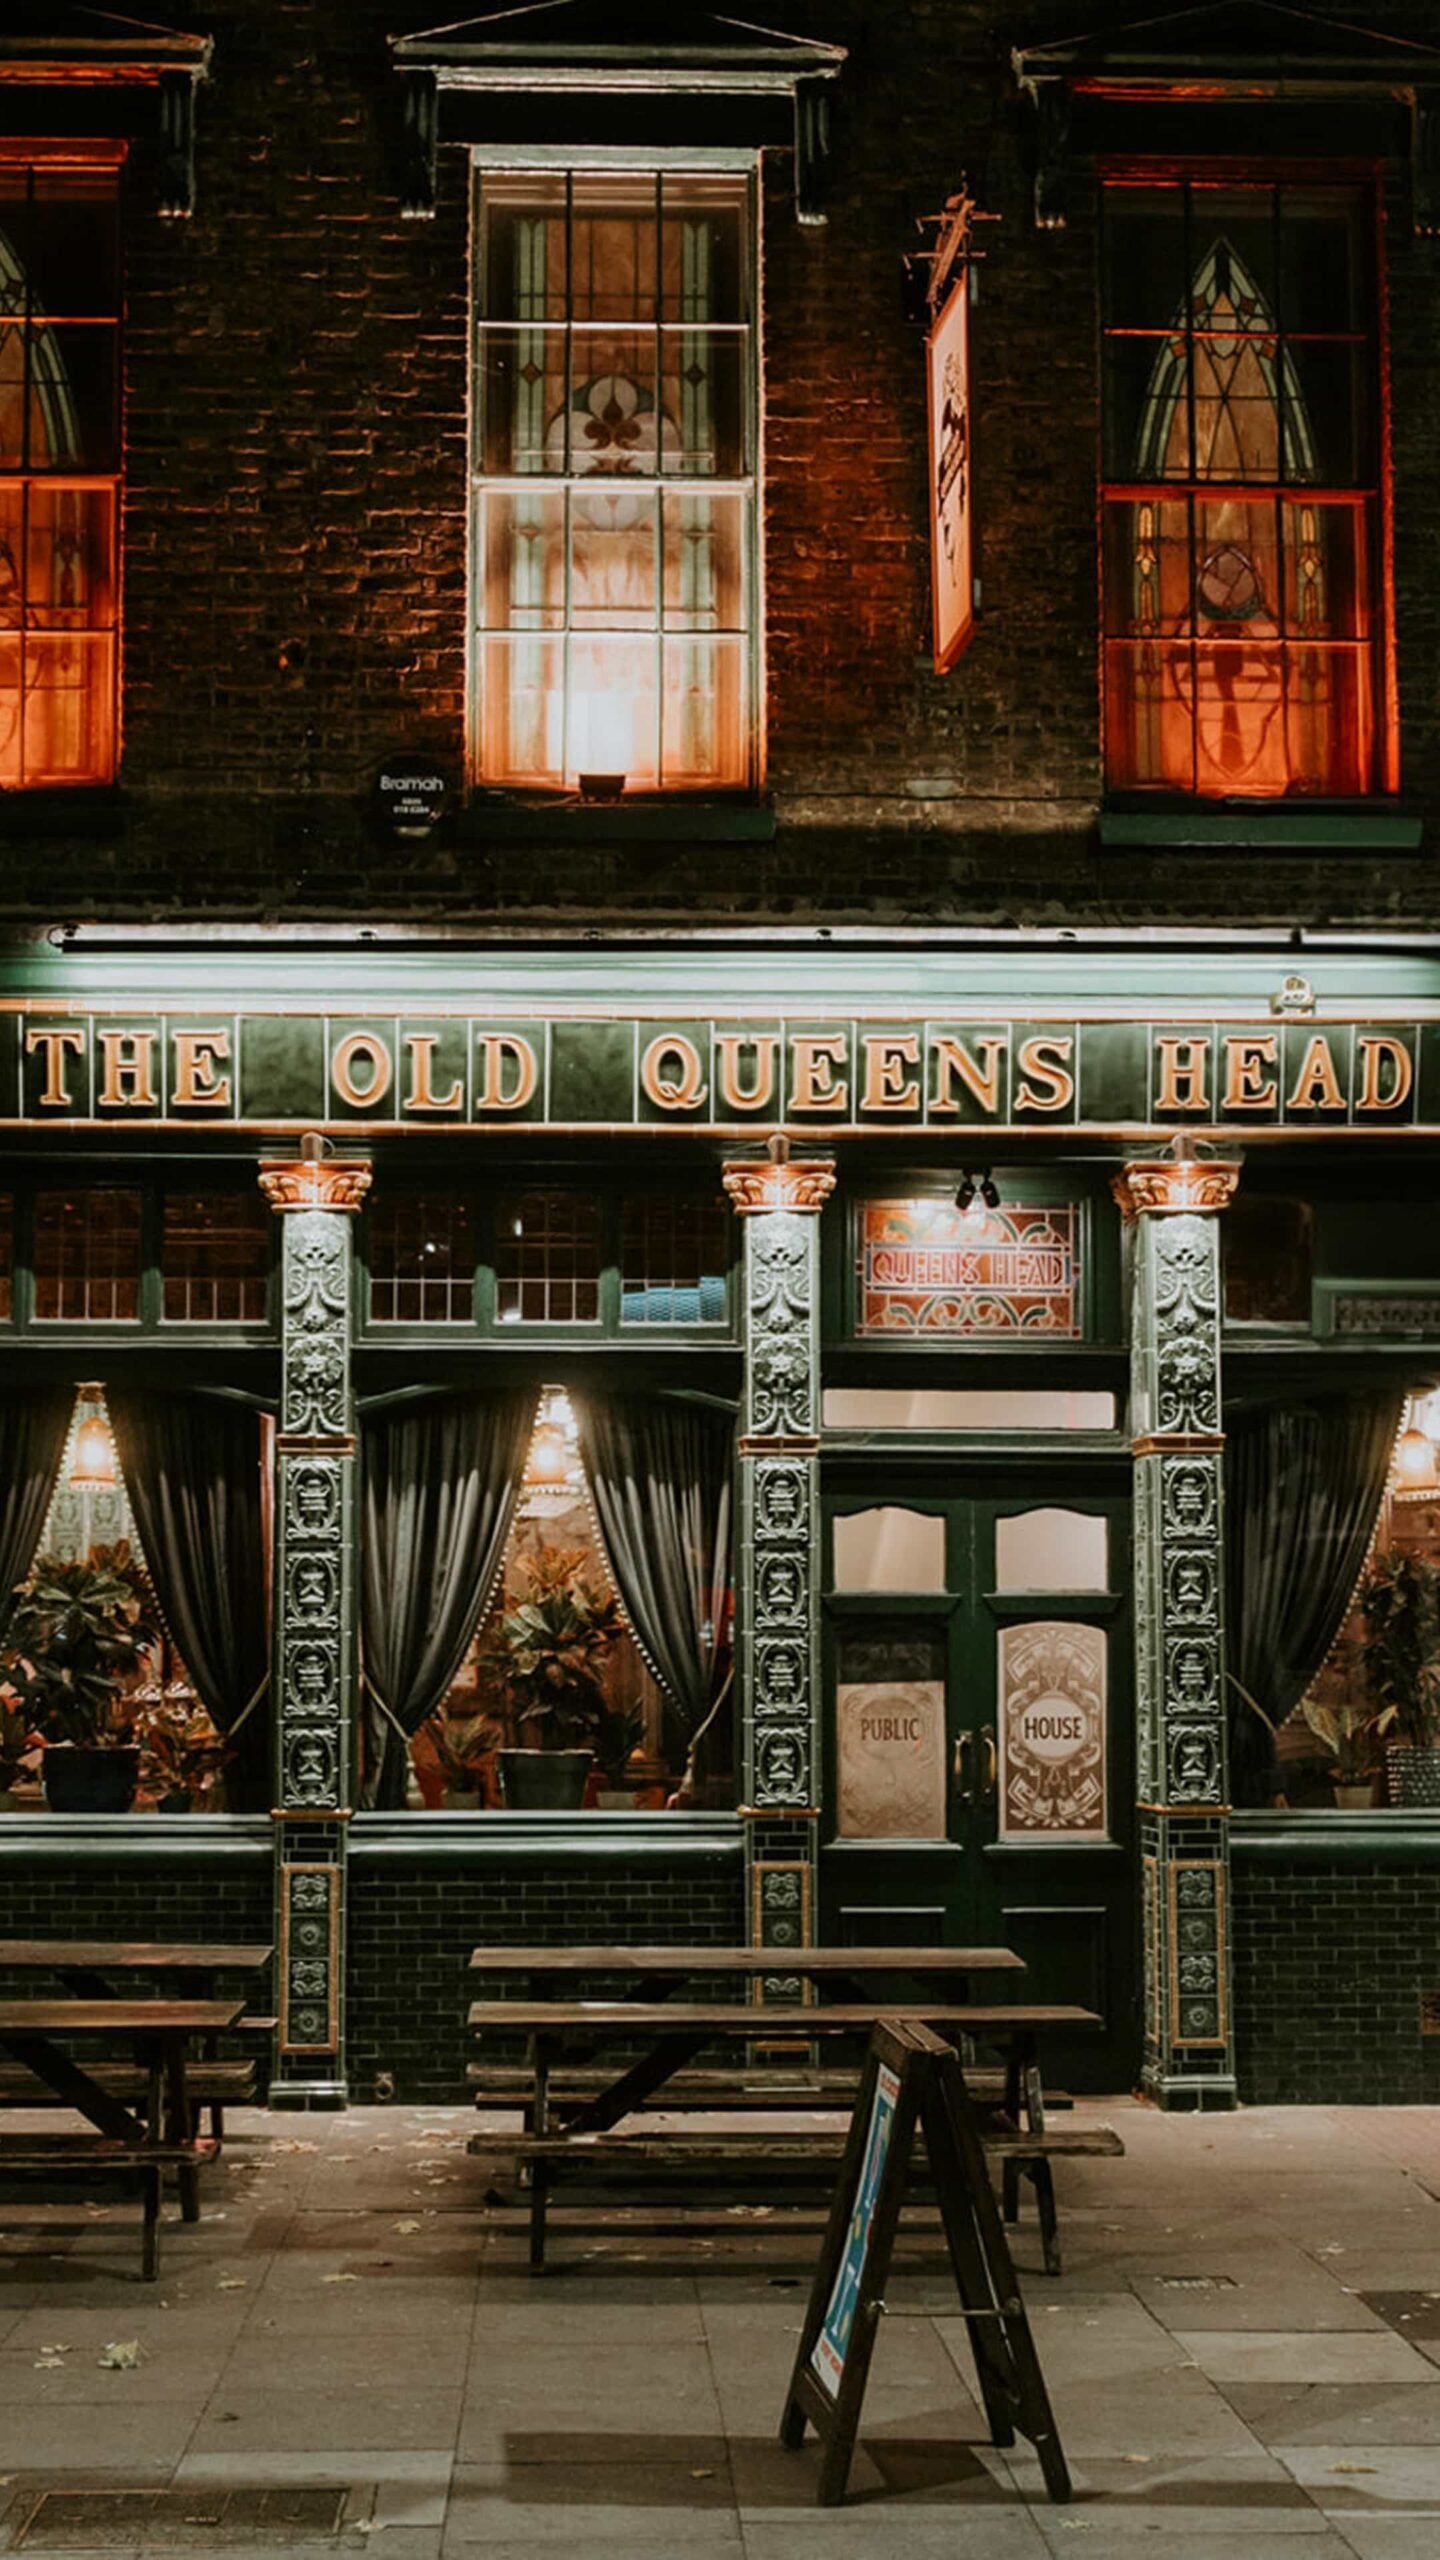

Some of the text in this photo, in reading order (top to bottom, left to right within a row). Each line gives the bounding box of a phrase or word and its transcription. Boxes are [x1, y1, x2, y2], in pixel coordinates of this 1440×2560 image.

[380, 775, 444, 791] Bramah
[26, 1029, 1413, 1113] THE OLD QUEENS HEAD
[873, 1252, 1063, 1285] QUEENS HEAD
[860, 1717, 920, 1741] PUBLIC
[1024, 1716, 1083, 1740] HOUSE
